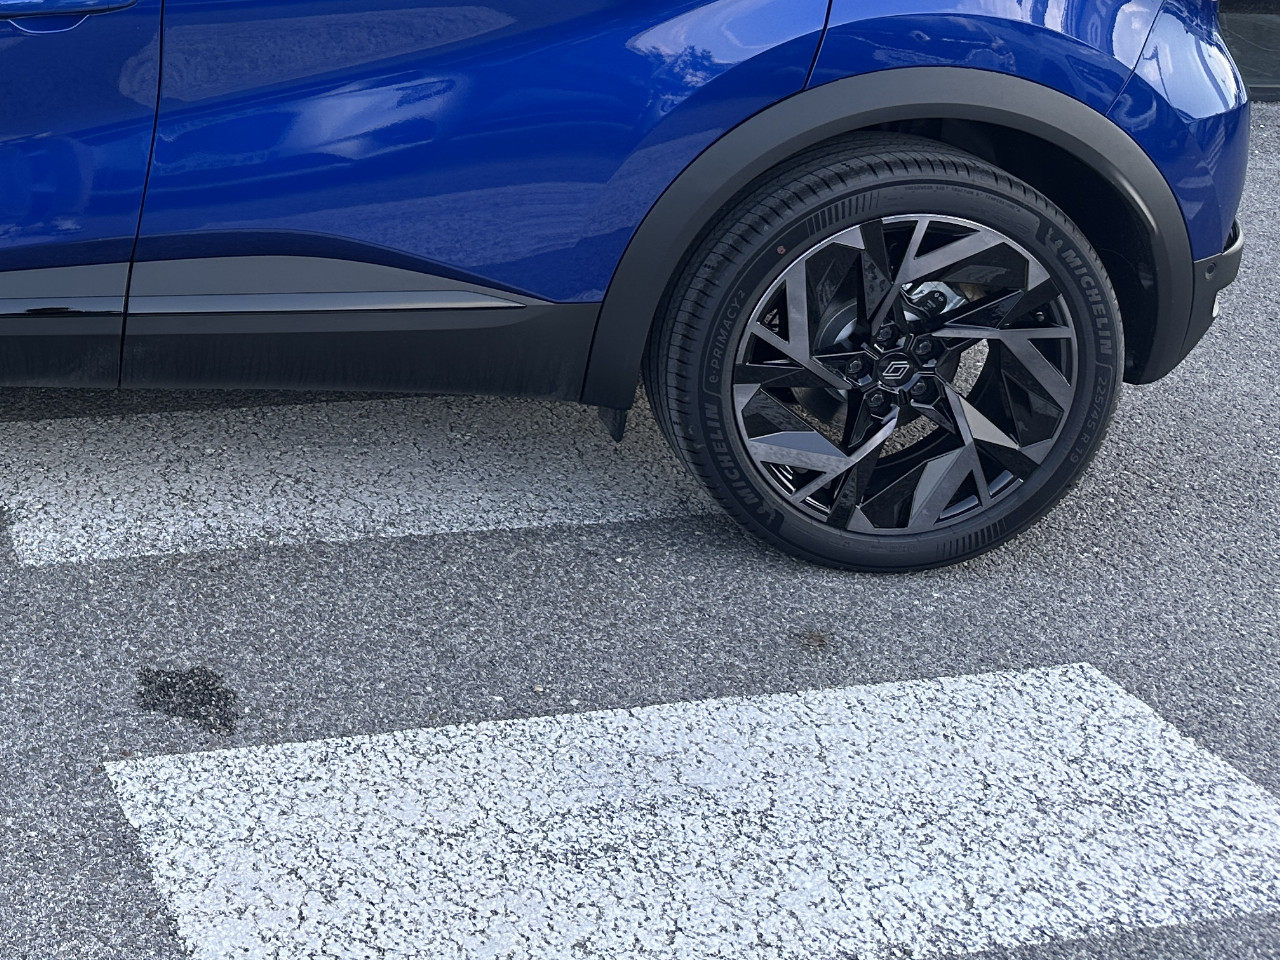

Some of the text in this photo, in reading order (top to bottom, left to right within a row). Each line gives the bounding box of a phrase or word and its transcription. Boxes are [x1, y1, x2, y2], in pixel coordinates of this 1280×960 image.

[1061, 248, 1112, 356] MICHELIN
[704, 402, 759, 509] MICHELIN
[1070, 376, 1107, 464] 225/45 R 19
